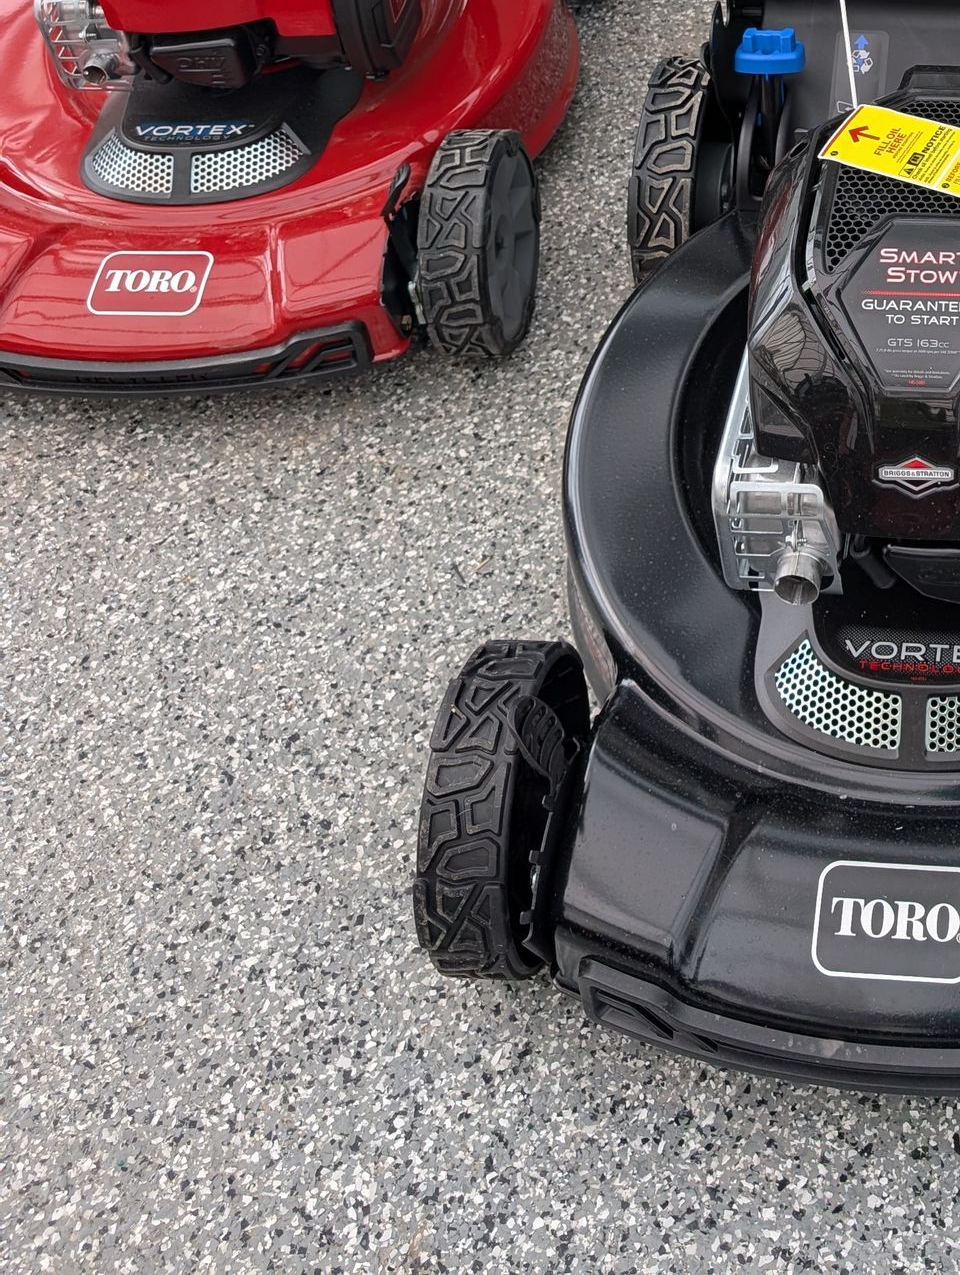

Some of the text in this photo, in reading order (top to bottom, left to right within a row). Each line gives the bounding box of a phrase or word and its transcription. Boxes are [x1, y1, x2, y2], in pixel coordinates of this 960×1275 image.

[874, 127, 902, 156] FILL OIL
[886, 133, 907, 154] HERE
[921, 125, 946, 154] NOTICE
[946, 162, 960, 183] BEFORE
[886, 314, 905, 324] TO
[888, 338, 949, 348] GTS 163cc
